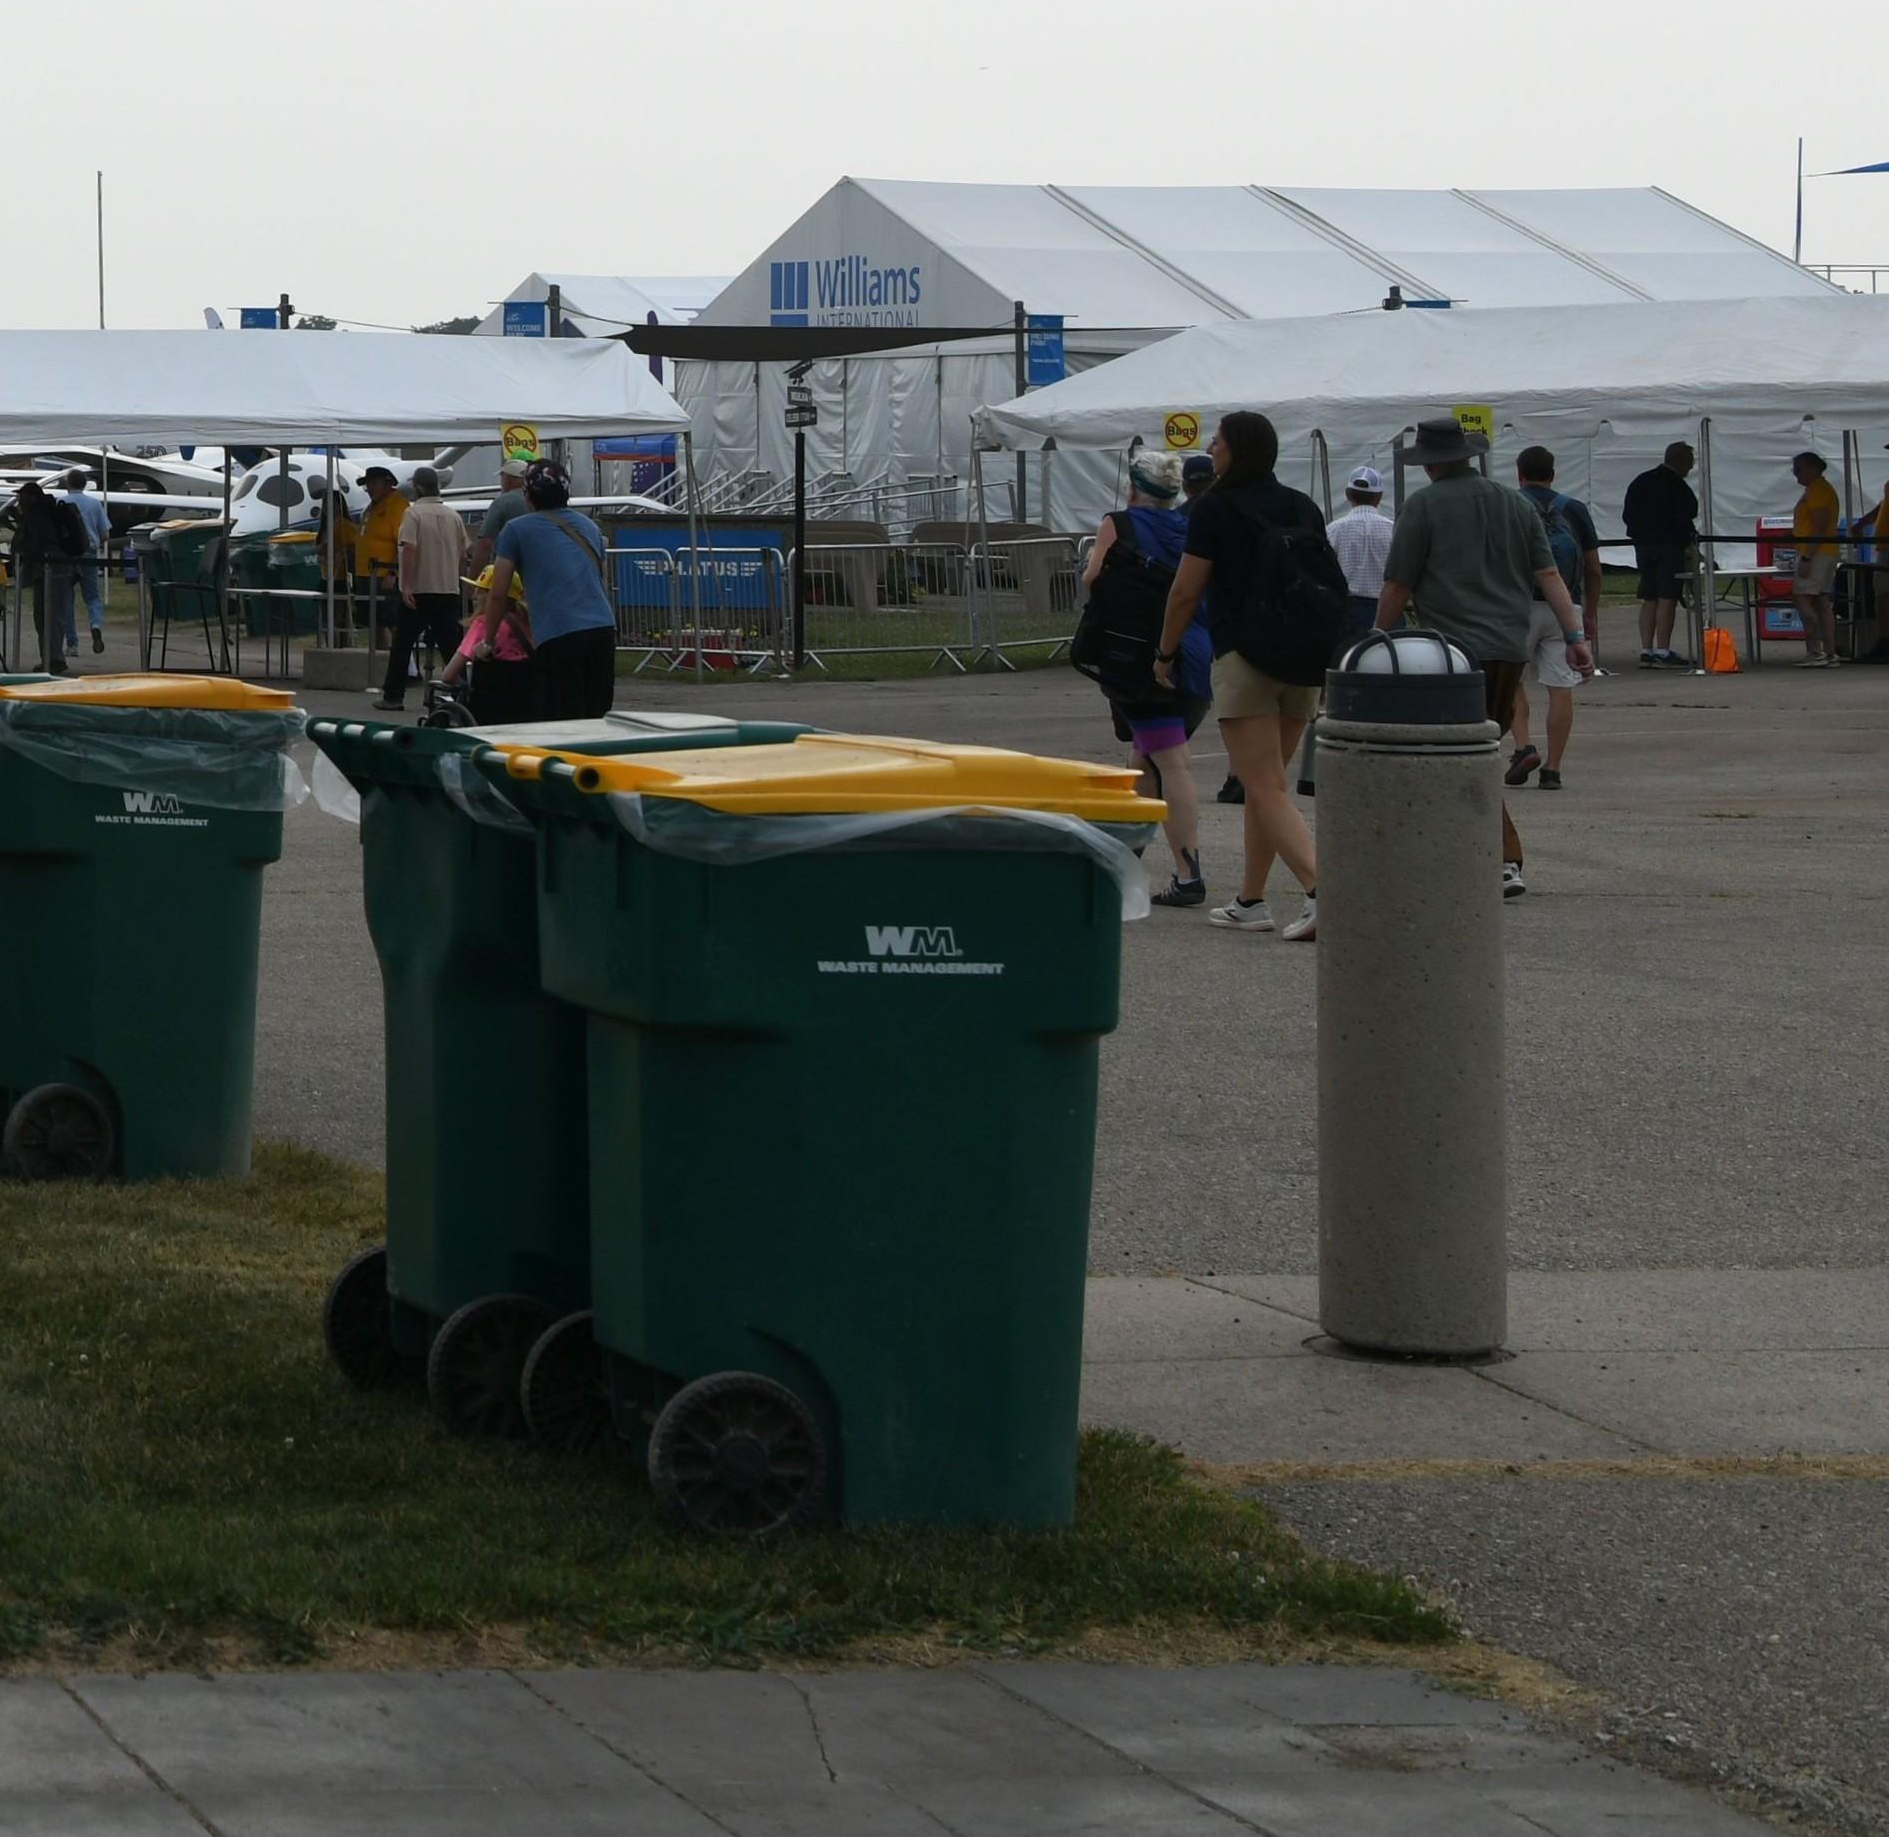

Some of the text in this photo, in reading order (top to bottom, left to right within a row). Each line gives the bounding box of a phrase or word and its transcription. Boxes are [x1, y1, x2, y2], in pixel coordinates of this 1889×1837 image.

[815, 255, 921, 308] Williams
[1461, 414, 1481, 425] Bag
[1168, 425, 1195, 438] Bags
[506, 436, 535, 449] Bags
[123, 792, 181, 814] WM
[95, 815, 209, 827] WASTE MANAGEMENT
[864, 925, 957, 957] WM
[817, 961, 1005, 974] WASTE MANAGEMENT
